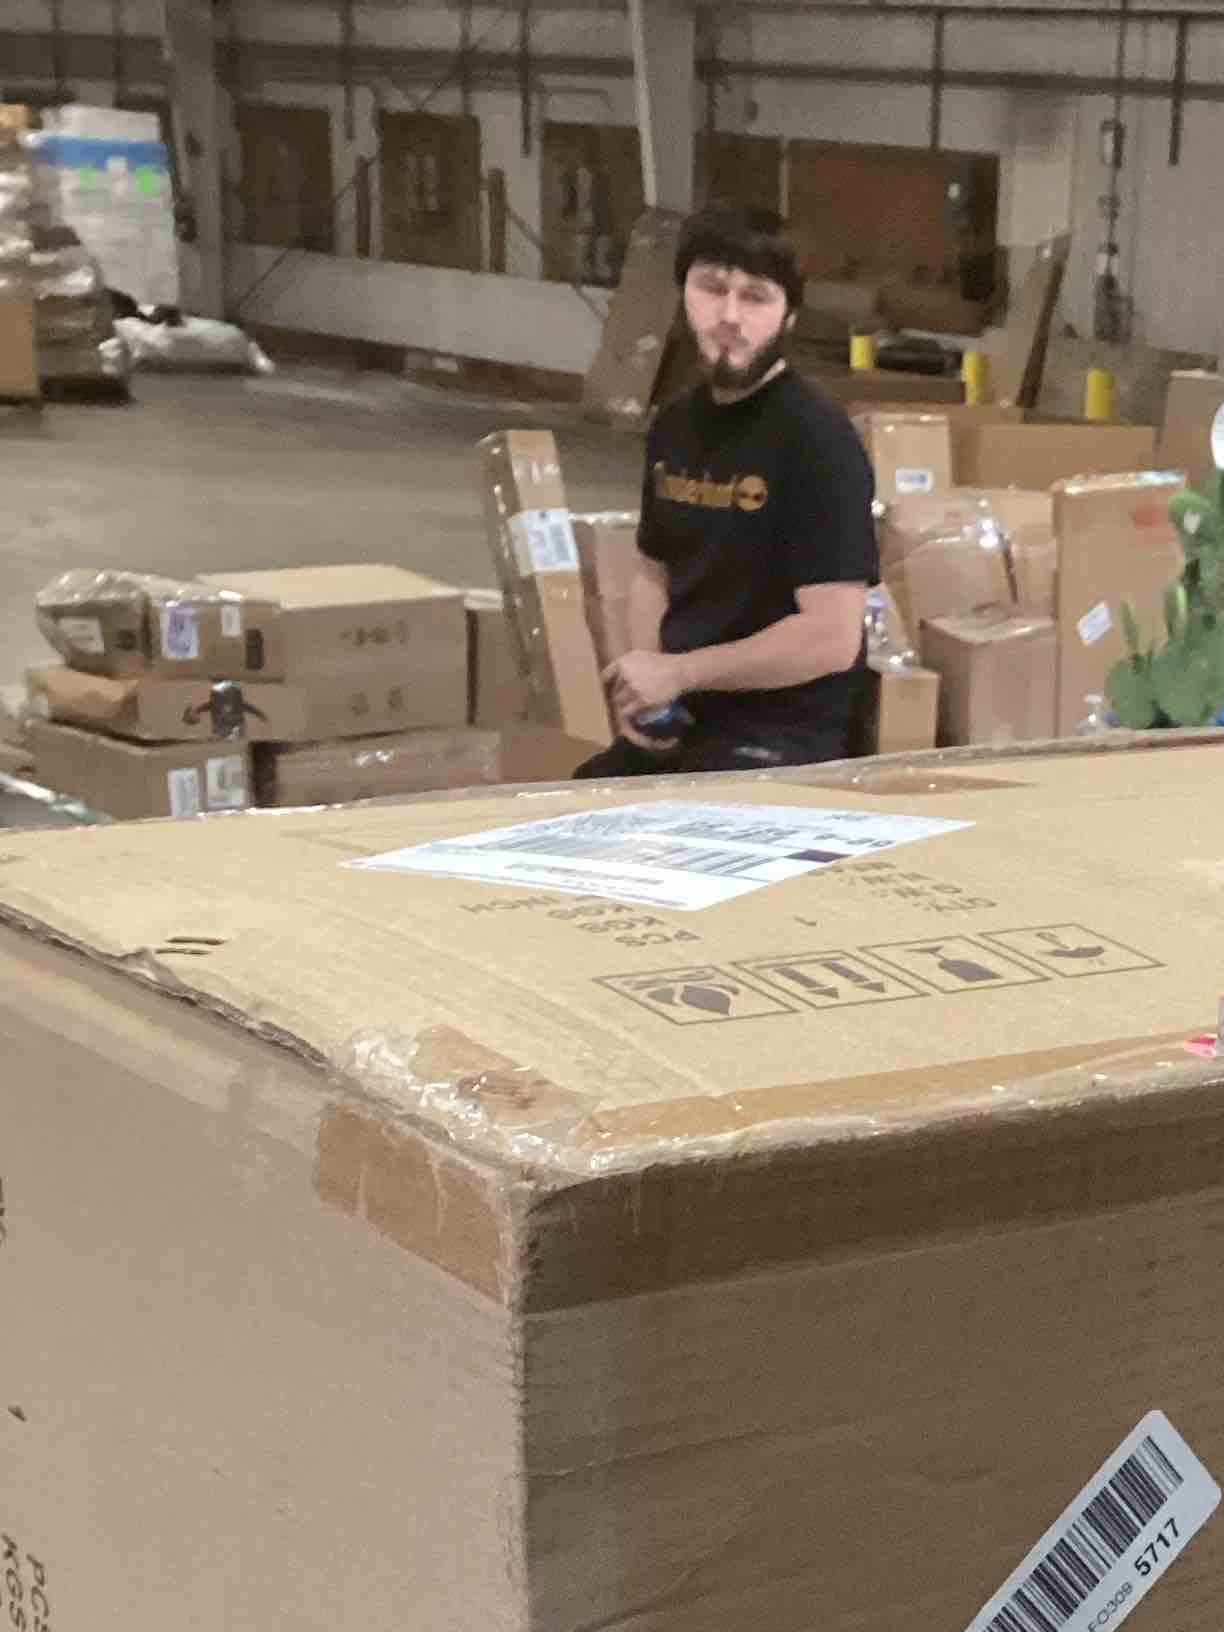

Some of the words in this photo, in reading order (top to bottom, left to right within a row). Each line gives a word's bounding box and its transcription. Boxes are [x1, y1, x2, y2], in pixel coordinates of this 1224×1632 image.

[614, 929, 701, 947] PCS
[1133, 1516, 1180, 1577] 5717
[1, 1531, 28, 1632] KGS
